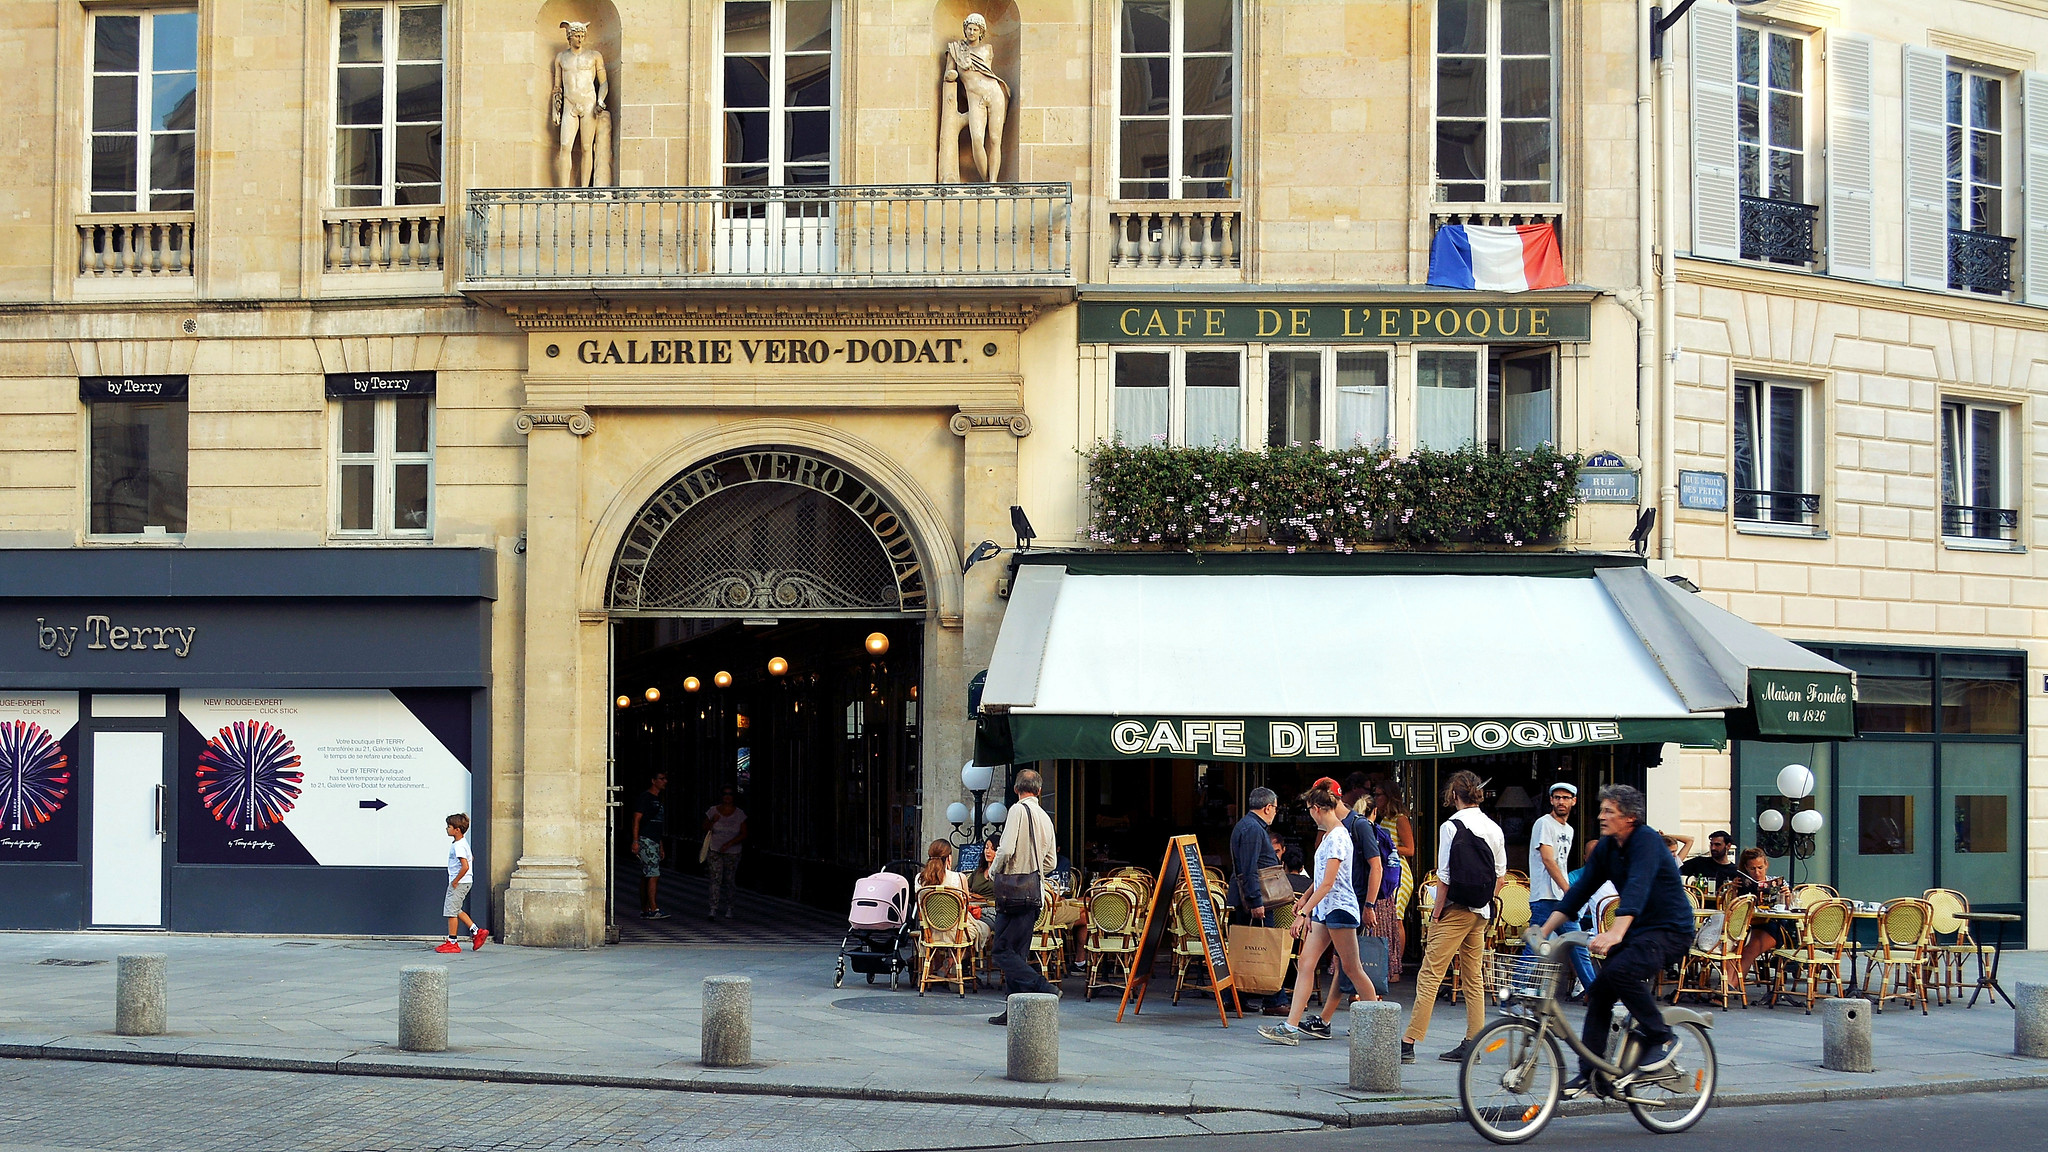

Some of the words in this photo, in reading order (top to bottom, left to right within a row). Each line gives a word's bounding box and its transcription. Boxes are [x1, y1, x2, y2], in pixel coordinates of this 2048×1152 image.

[1119, 308, 1225, 337] CAFE
[1255, 308, 1311, 337] DE
[1341, 308, 1550, 338] L'EPOQUE
[577, 340, 732, 365] GALERIE
[738, 339, 968, 365] VERO-DODAT.
[107, 380, 123, 395] by
[124, 379, 163, 395] Terry
[353, 378, 370, 393] by
[370, 376, 410, 391] Terry
[1592, 477, 1615, 486] RUE
[1684, 475, 1700, 485] RUE
[1700, 478, 1721, 487] CROIX
[1594, 488, 1629, 497] BOULOI
[1683, 485, 1697, 494] DES
[1698, 487, 1723, 497] PETITS
[615, 464, 725, 602] GALERIE
[738, 453, 844, 494] VERO
[849, 488, 928, 606] DODAT
[36, 617, 79, 657] by
[85, 614, 197, 658] Terry
[1761, 681, 1802, 703] Maison
[1806, 683, 1847, 703] Fondée
[1787, 711, 1800, 722] en
[1802, 709, 1827, 722] 1826
[335, 738, 351, 746] Votre
[351, 738, 375, 747] boutique
[1110, 720, 1247, 757] CAFE
[1268, 721, 1340, 757] DE
[1359, 720, 1624, 756] L'EPOQUE
[379, 767, 404, 775] boutique
